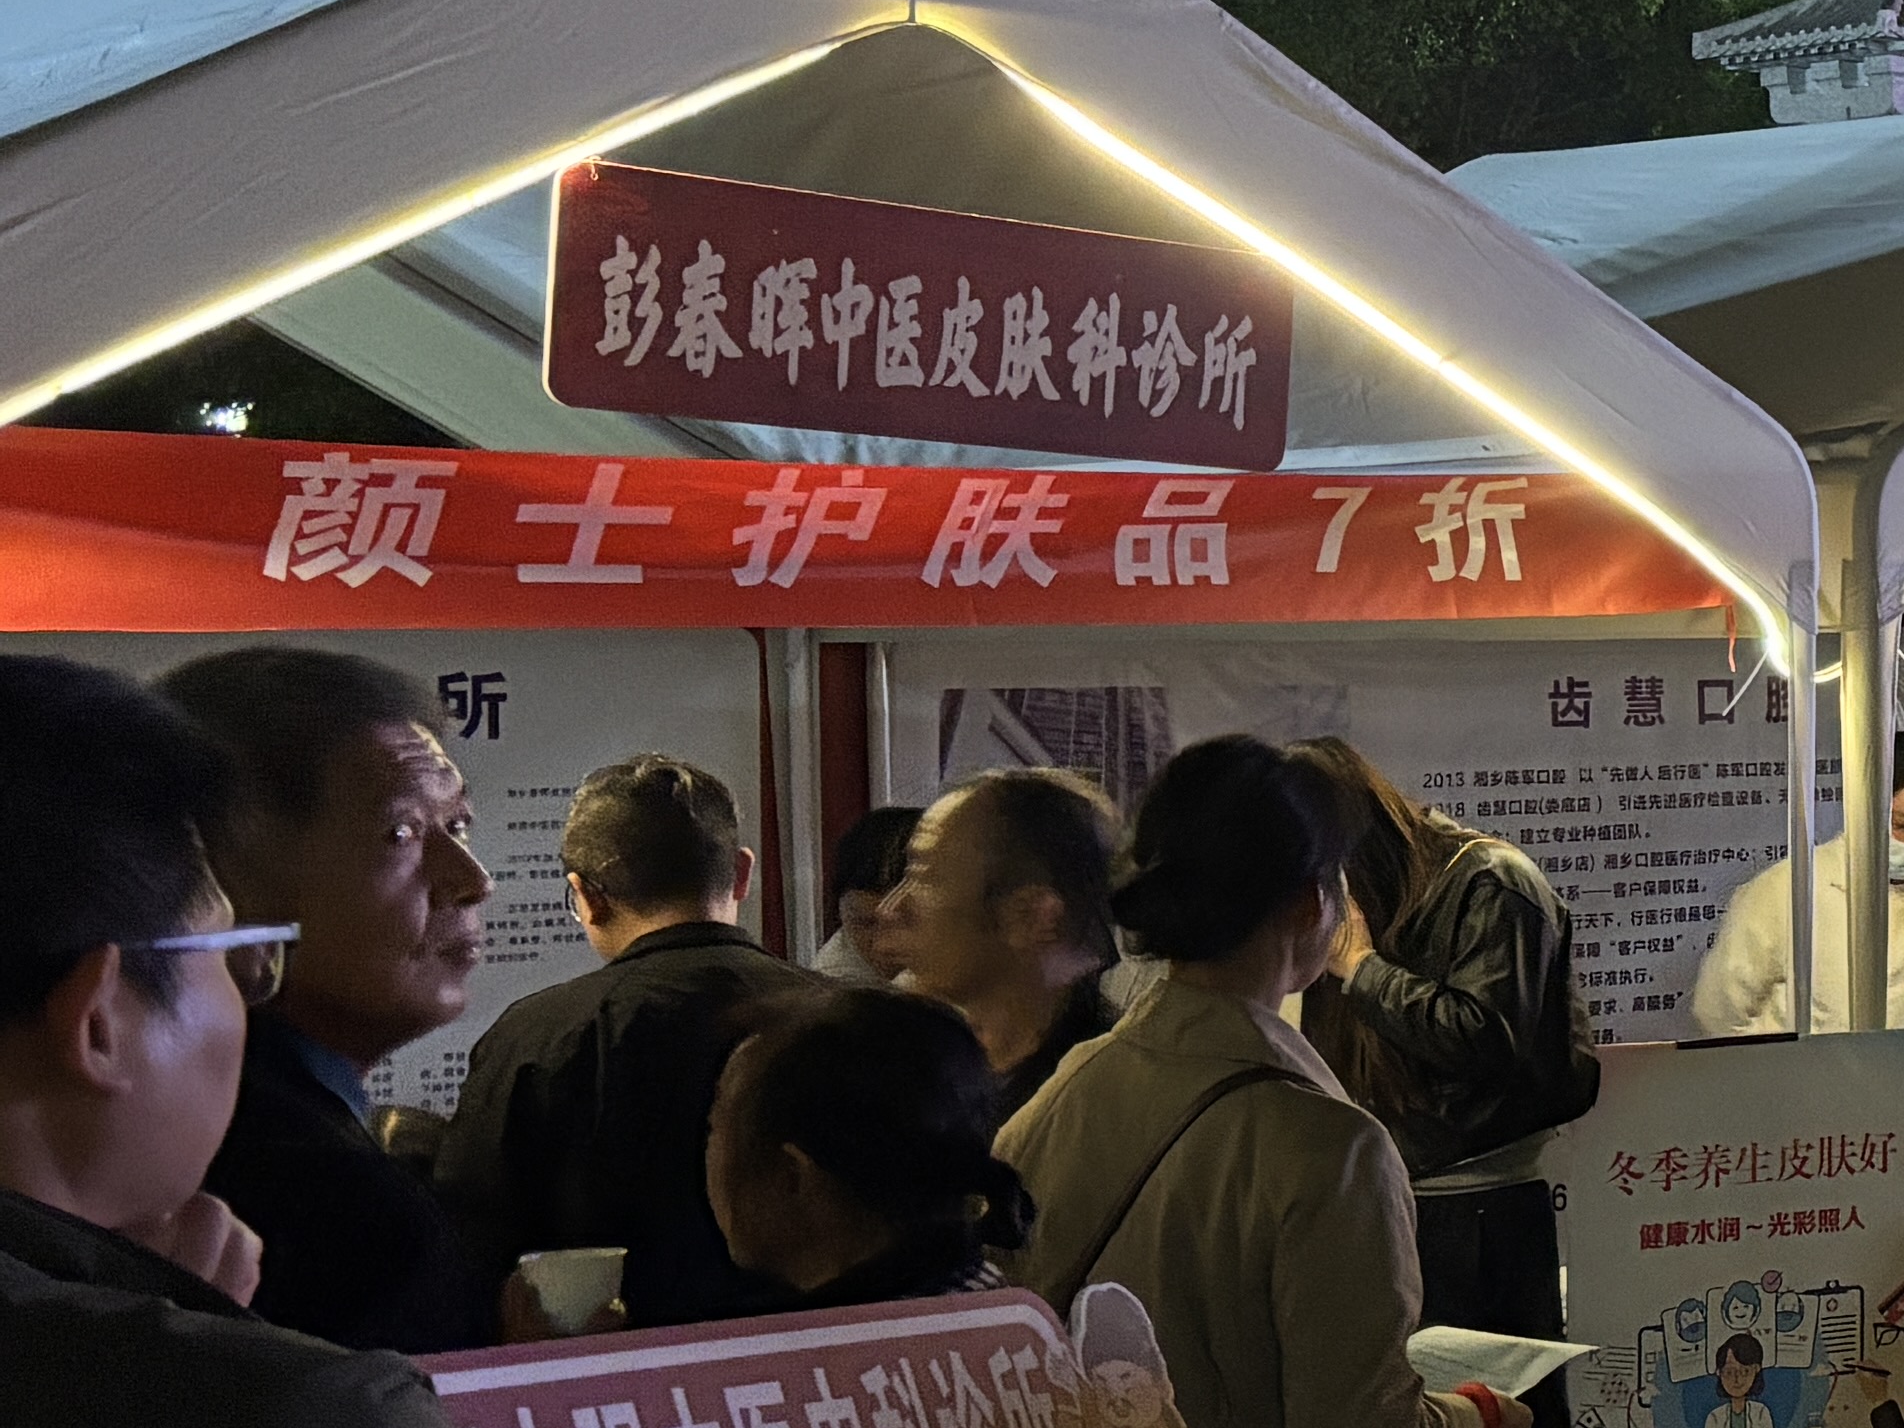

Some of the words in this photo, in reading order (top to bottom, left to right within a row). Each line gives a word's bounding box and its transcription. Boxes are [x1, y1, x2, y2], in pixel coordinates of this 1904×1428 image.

[596, 235, 1257, 430] 彭春晖中医皮肤科诊所
[1422, 771, 1465, 789] 2013
[1607, 1131, 1898, 1197] 冬季养生皮肤好
